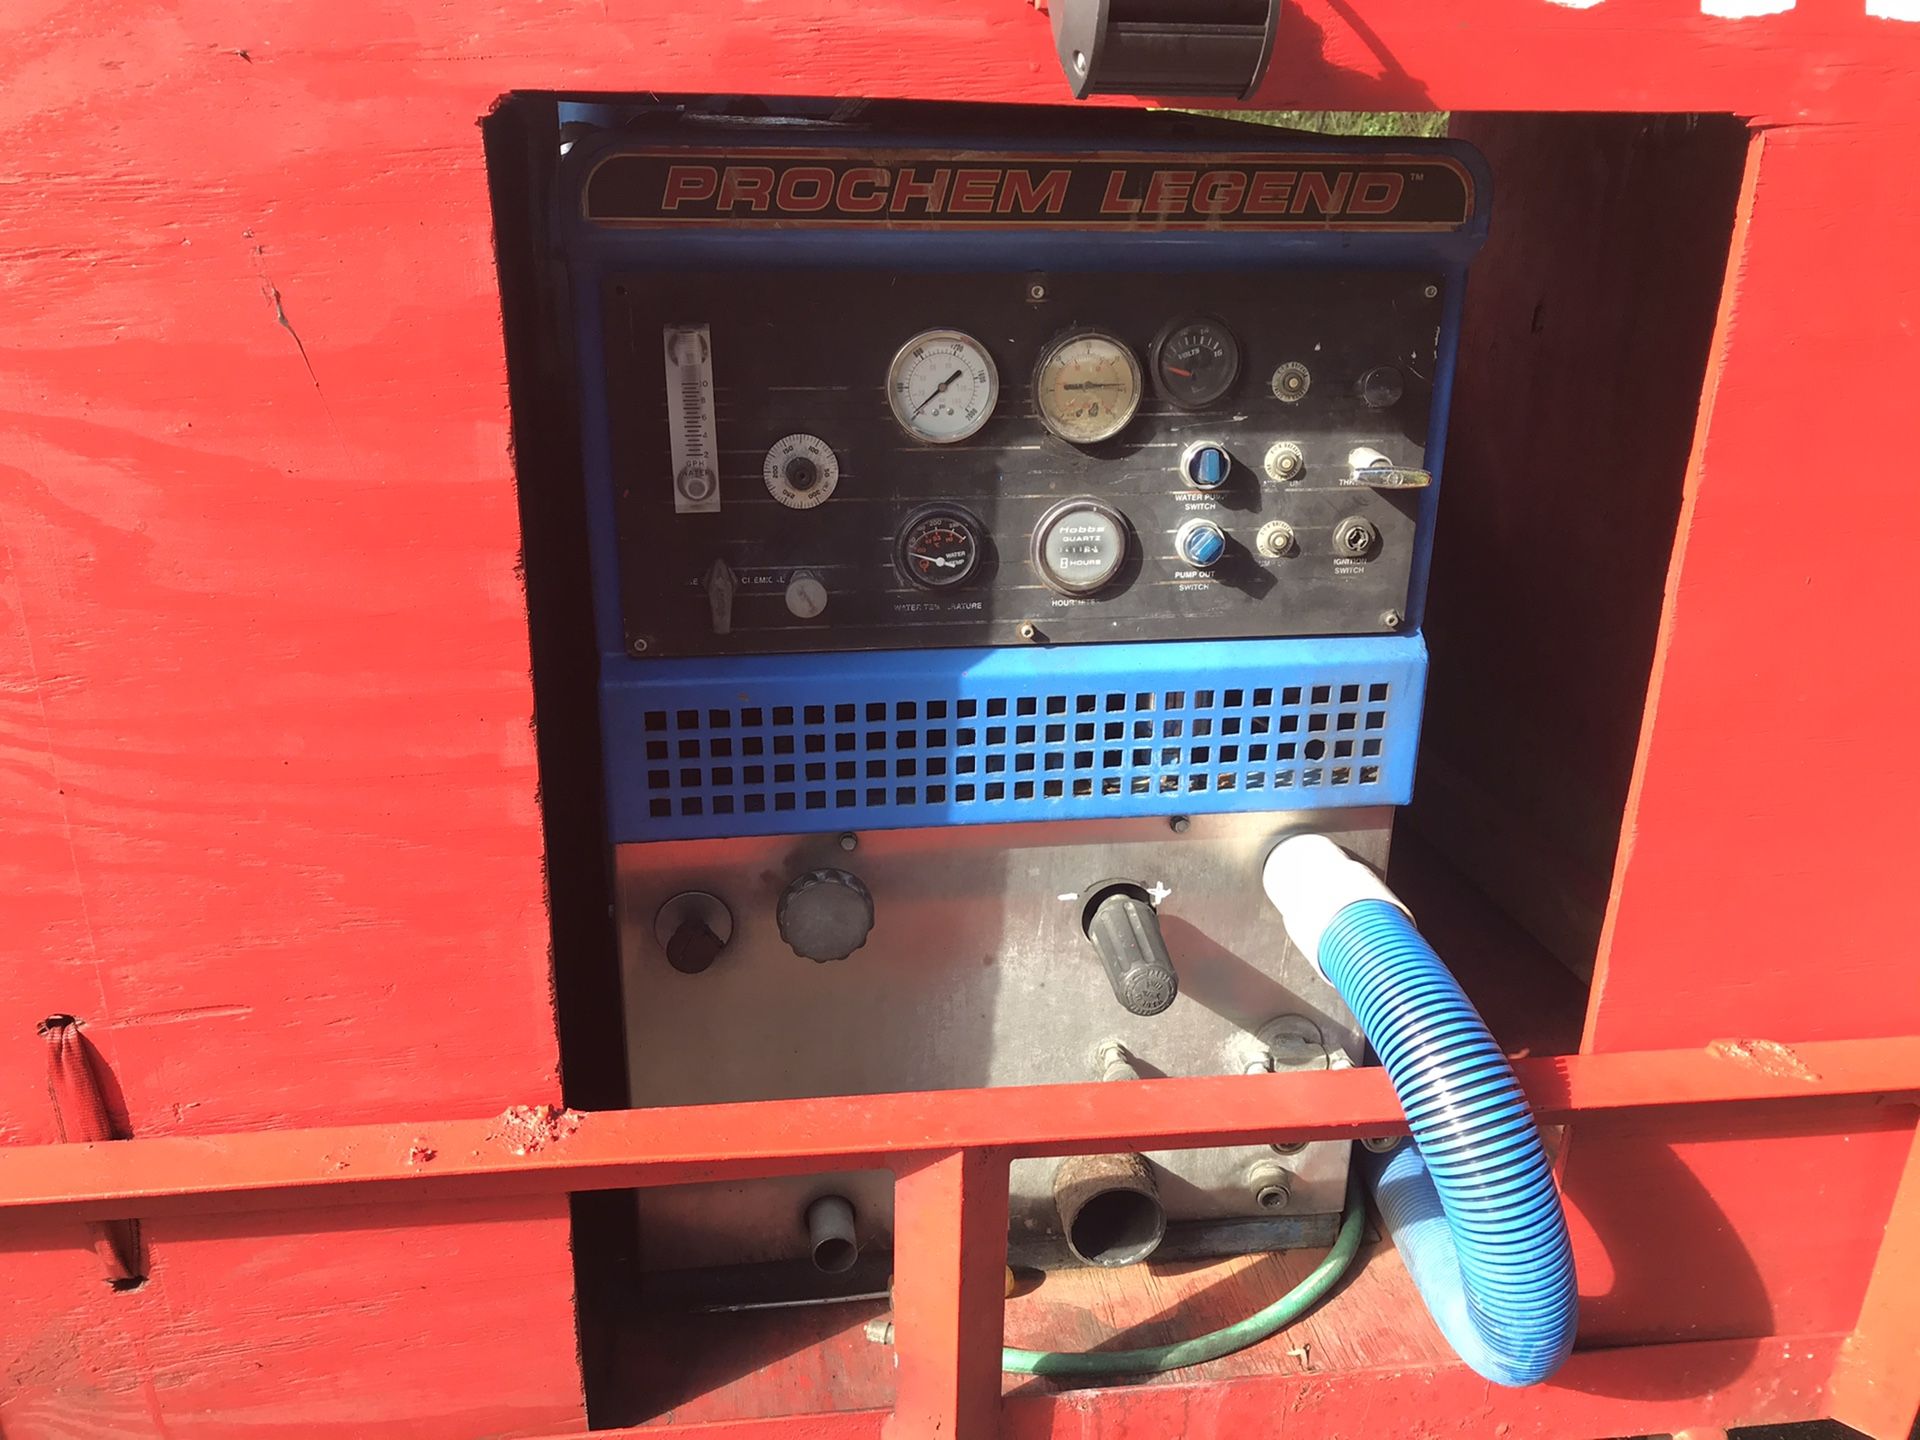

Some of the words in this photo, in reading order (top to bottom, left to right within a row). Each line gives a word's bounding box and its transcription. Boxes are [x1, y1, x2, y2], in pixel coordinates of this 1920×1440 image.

[661, 165, 1073, 214] PROCHEM
[1099, 169, 1405, 214] LEGEND
[1178, 347, 1201, 360] VOLTS
[782, 445, 794, 455] 150
[808, 445, 819, 455] 100
[686, 460, 705, 468] GPH
[1184, 503, 1216, 511] SWITCH
[1059, 526, 1105, 534] Hobbs
[945, 550, 966, 559] WATER
[1198, 570, 1215, 578] OUT
[1334, 567, 1365, 575] SWITCH
[1179, 583, 1210, 591] SWITCH
[1051, 599, 1075, 607] HOUR
